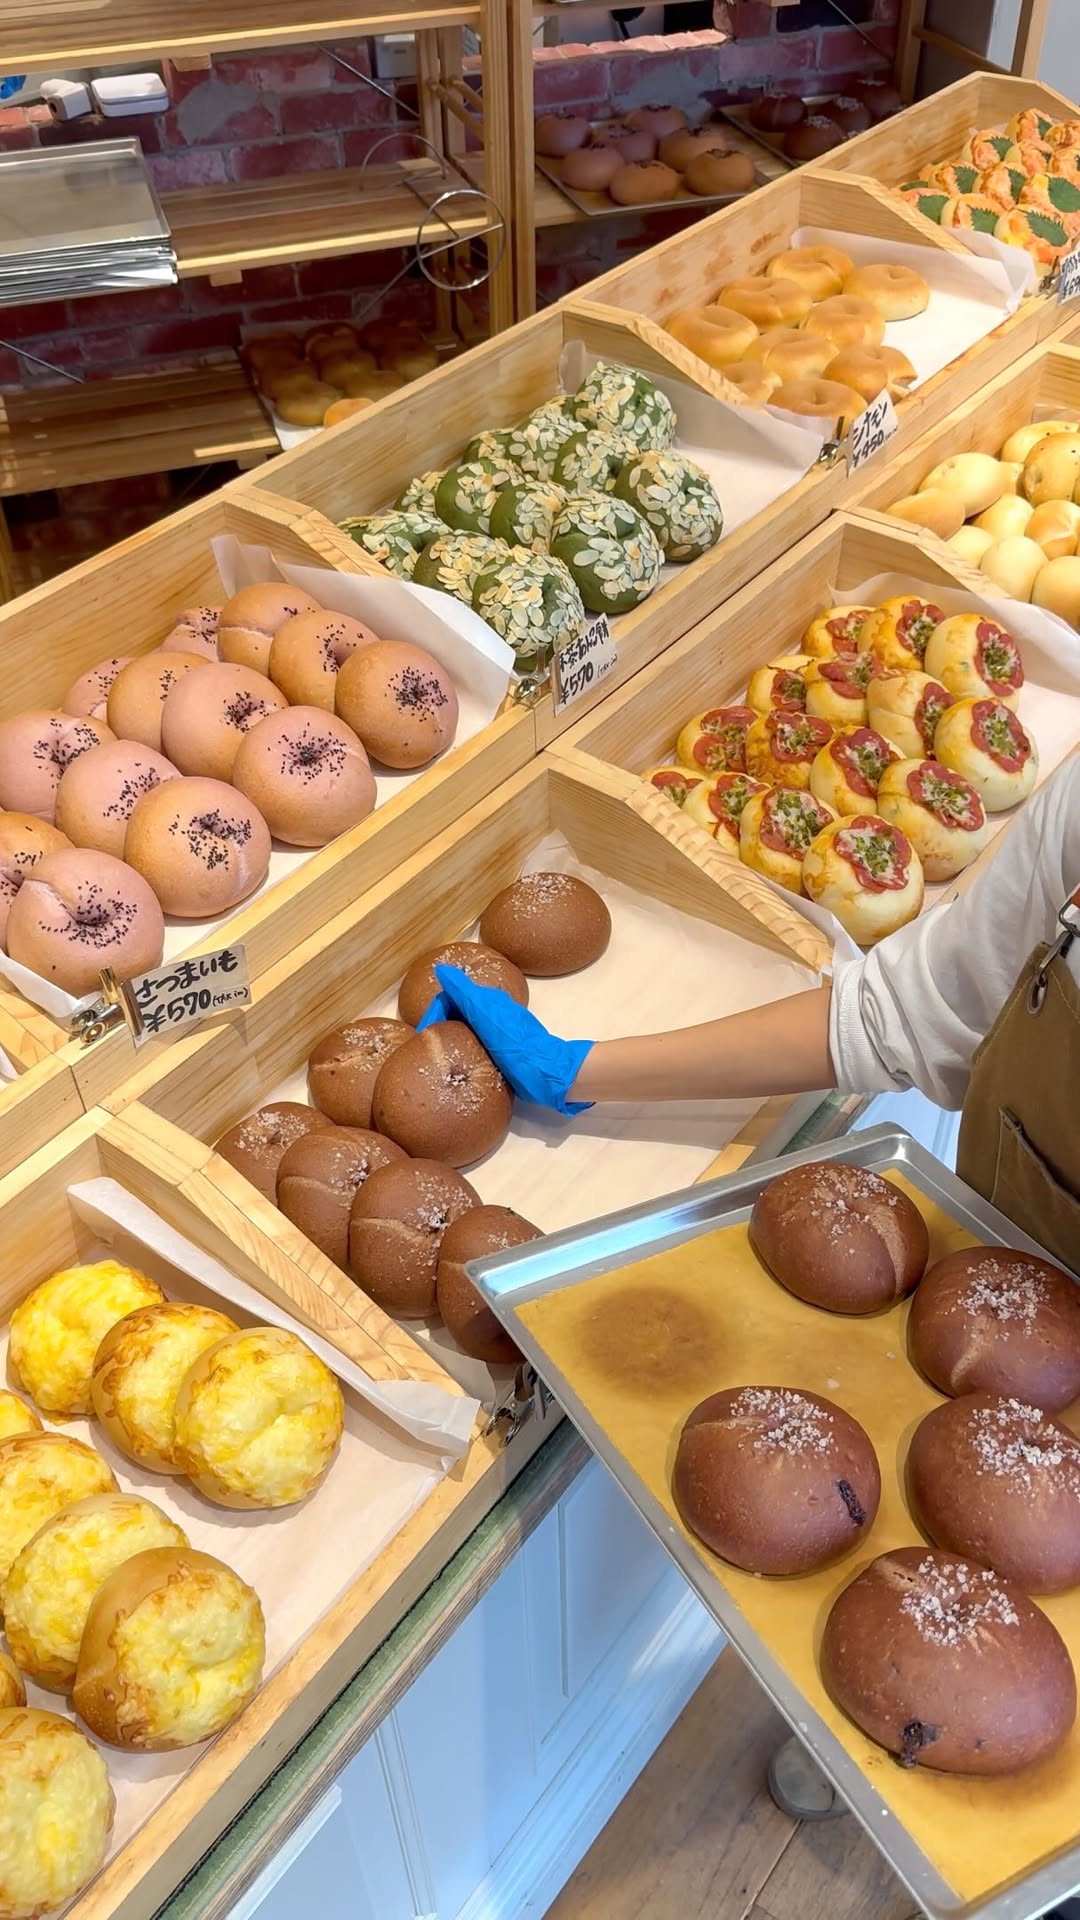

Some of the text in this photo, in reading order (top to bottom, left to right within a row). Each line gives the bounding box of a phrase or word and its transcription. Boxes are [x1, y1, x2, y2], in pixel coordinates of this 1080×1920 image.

[853, 402, 887, 450] シナモン
[561, 661, 593, 704] ¥570
[134, 950, 238, 1008] さつまいも
[142, 989, 211, 1032] ¥570
